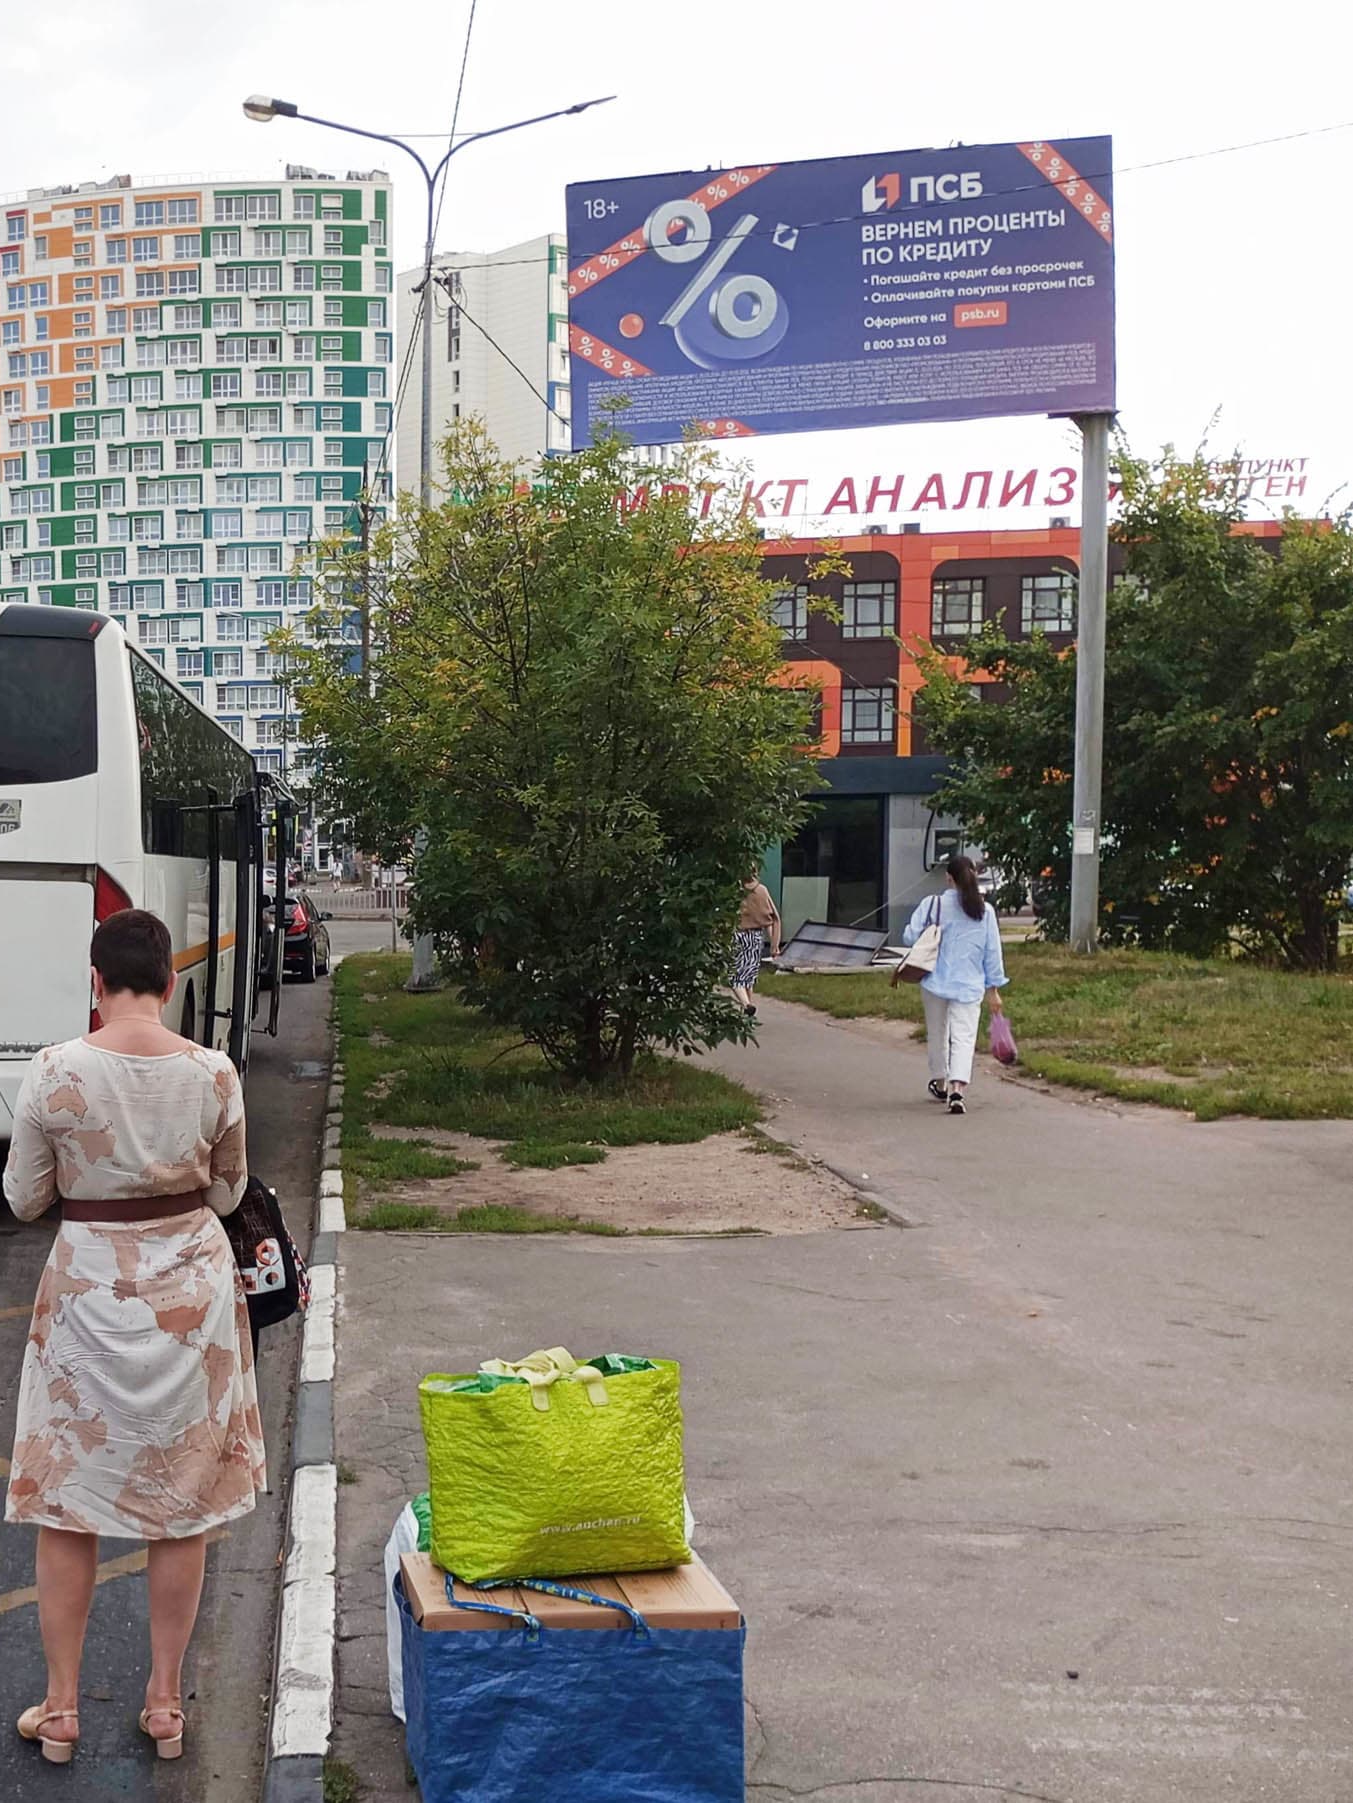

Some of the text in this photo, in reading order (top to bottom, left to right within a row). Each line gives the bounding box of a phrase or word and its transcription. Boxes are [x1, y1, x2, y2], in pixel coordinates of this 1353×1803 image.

[910, 171, 984, 203] ПСБ
[584, 198, 619, 219] 18+
[861, 208, 1066, 243] ВЕРНЕМ ПРОЦЕНТЫ
[861, 238, 993, 266] ПО КРЕДИТУ
[871, 260, 1085, 287] Погашайте кредит без просрочек
[871, 275, 1096, 304] Оплачивайте покупки картами ПСБ
[864, 307, 1000, 330] Оформите на psb.ru
[863, 335, 947, 351] 8 800 333 03 03
[738, 478, 809, 518] КТ
[822, 466, 1080, 515] АНАЛИЗ
